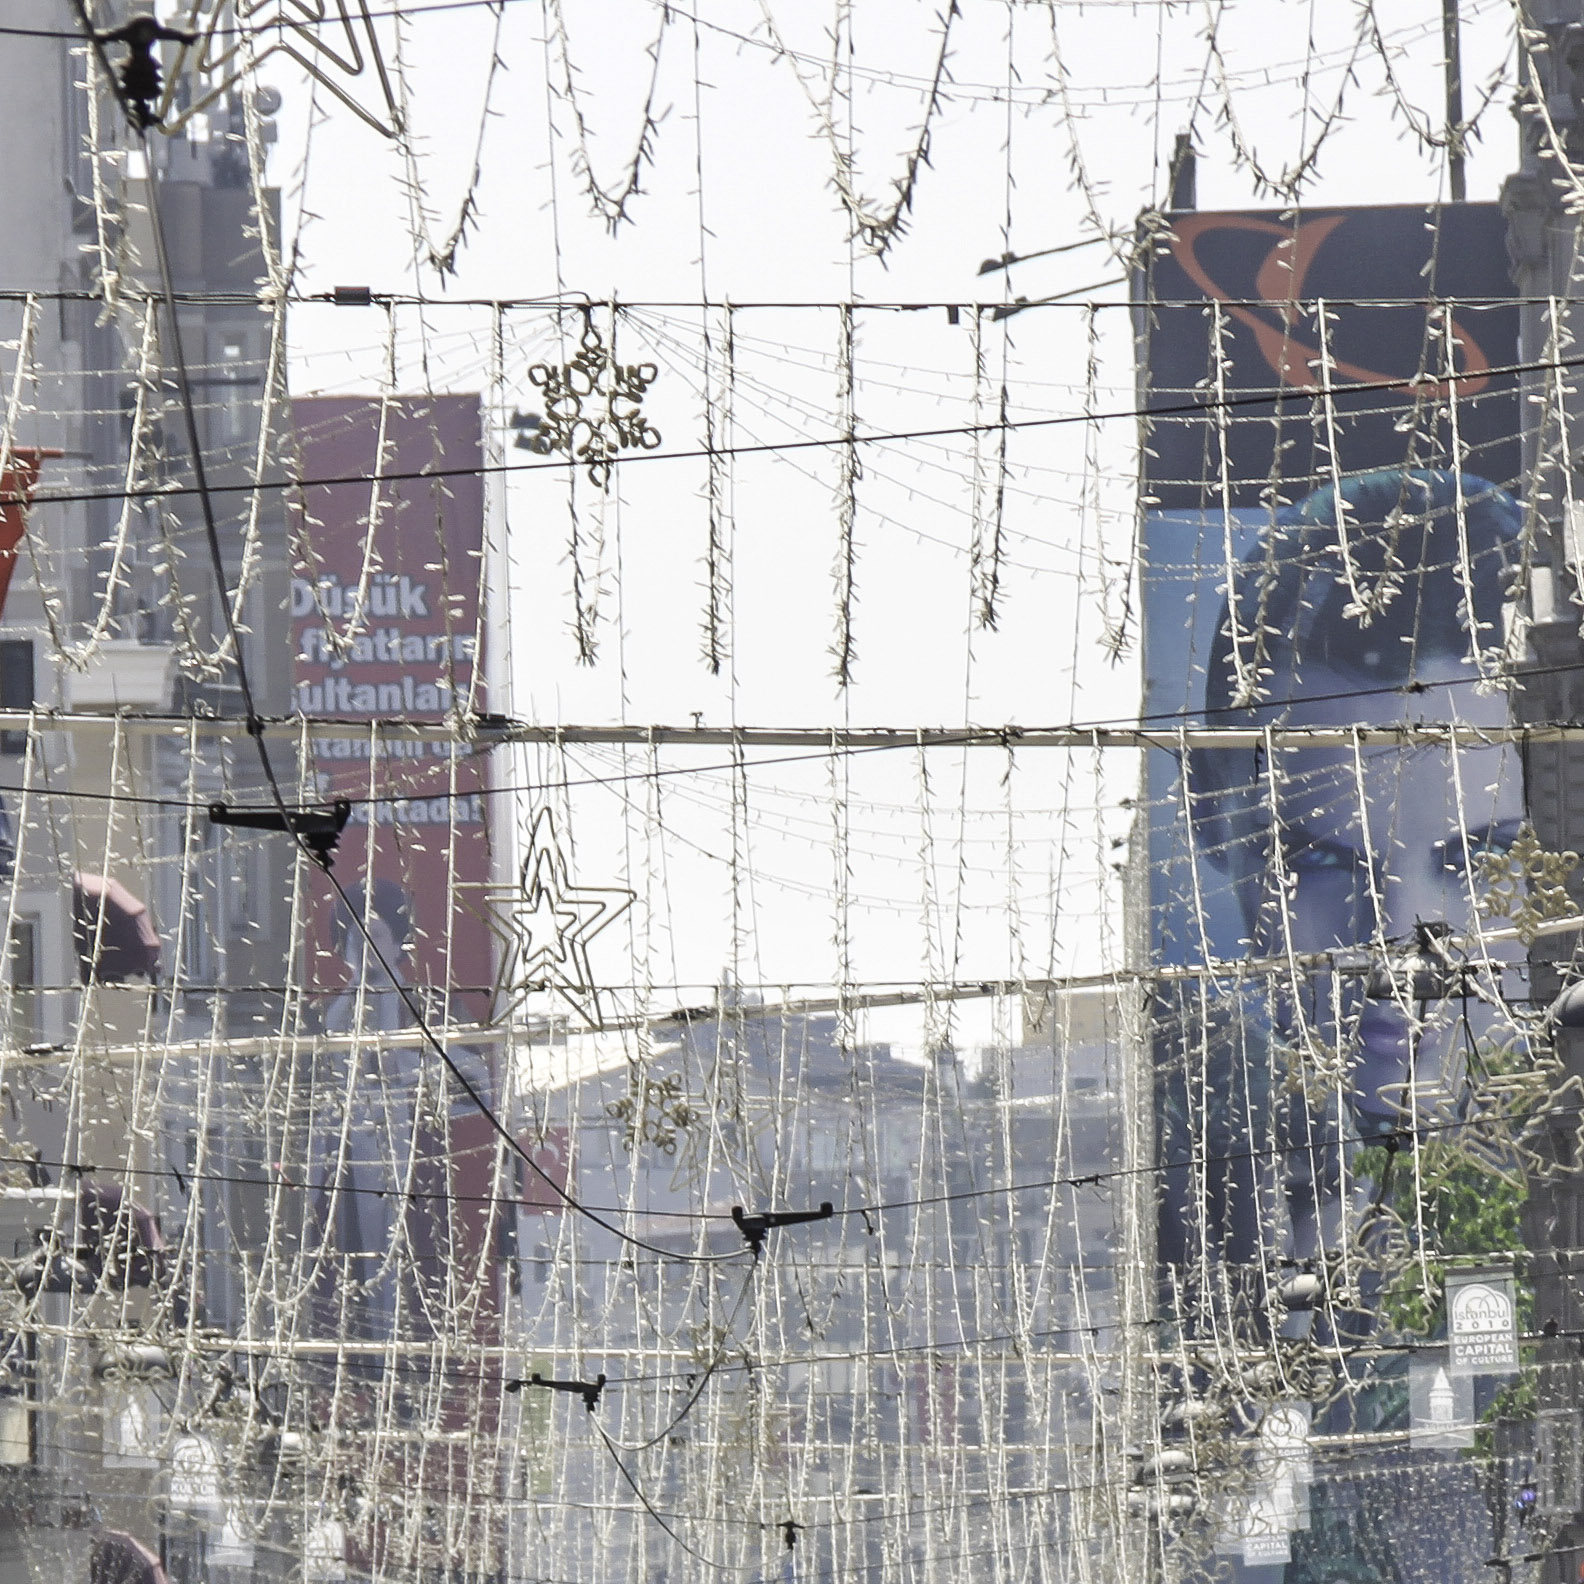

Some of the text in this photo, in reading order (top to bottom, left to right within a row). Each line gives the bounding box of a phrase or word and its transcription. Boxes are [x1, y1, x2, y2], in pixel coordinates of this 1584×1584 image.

[1456, 1319, 1510, 1331] 2010
[1454, 1332, 1513, 1345] EUROPEAN
[1455, 1343, 1514, 1358] CAPITAL
[1471, 1354, 1514, 1366] CULTURE
